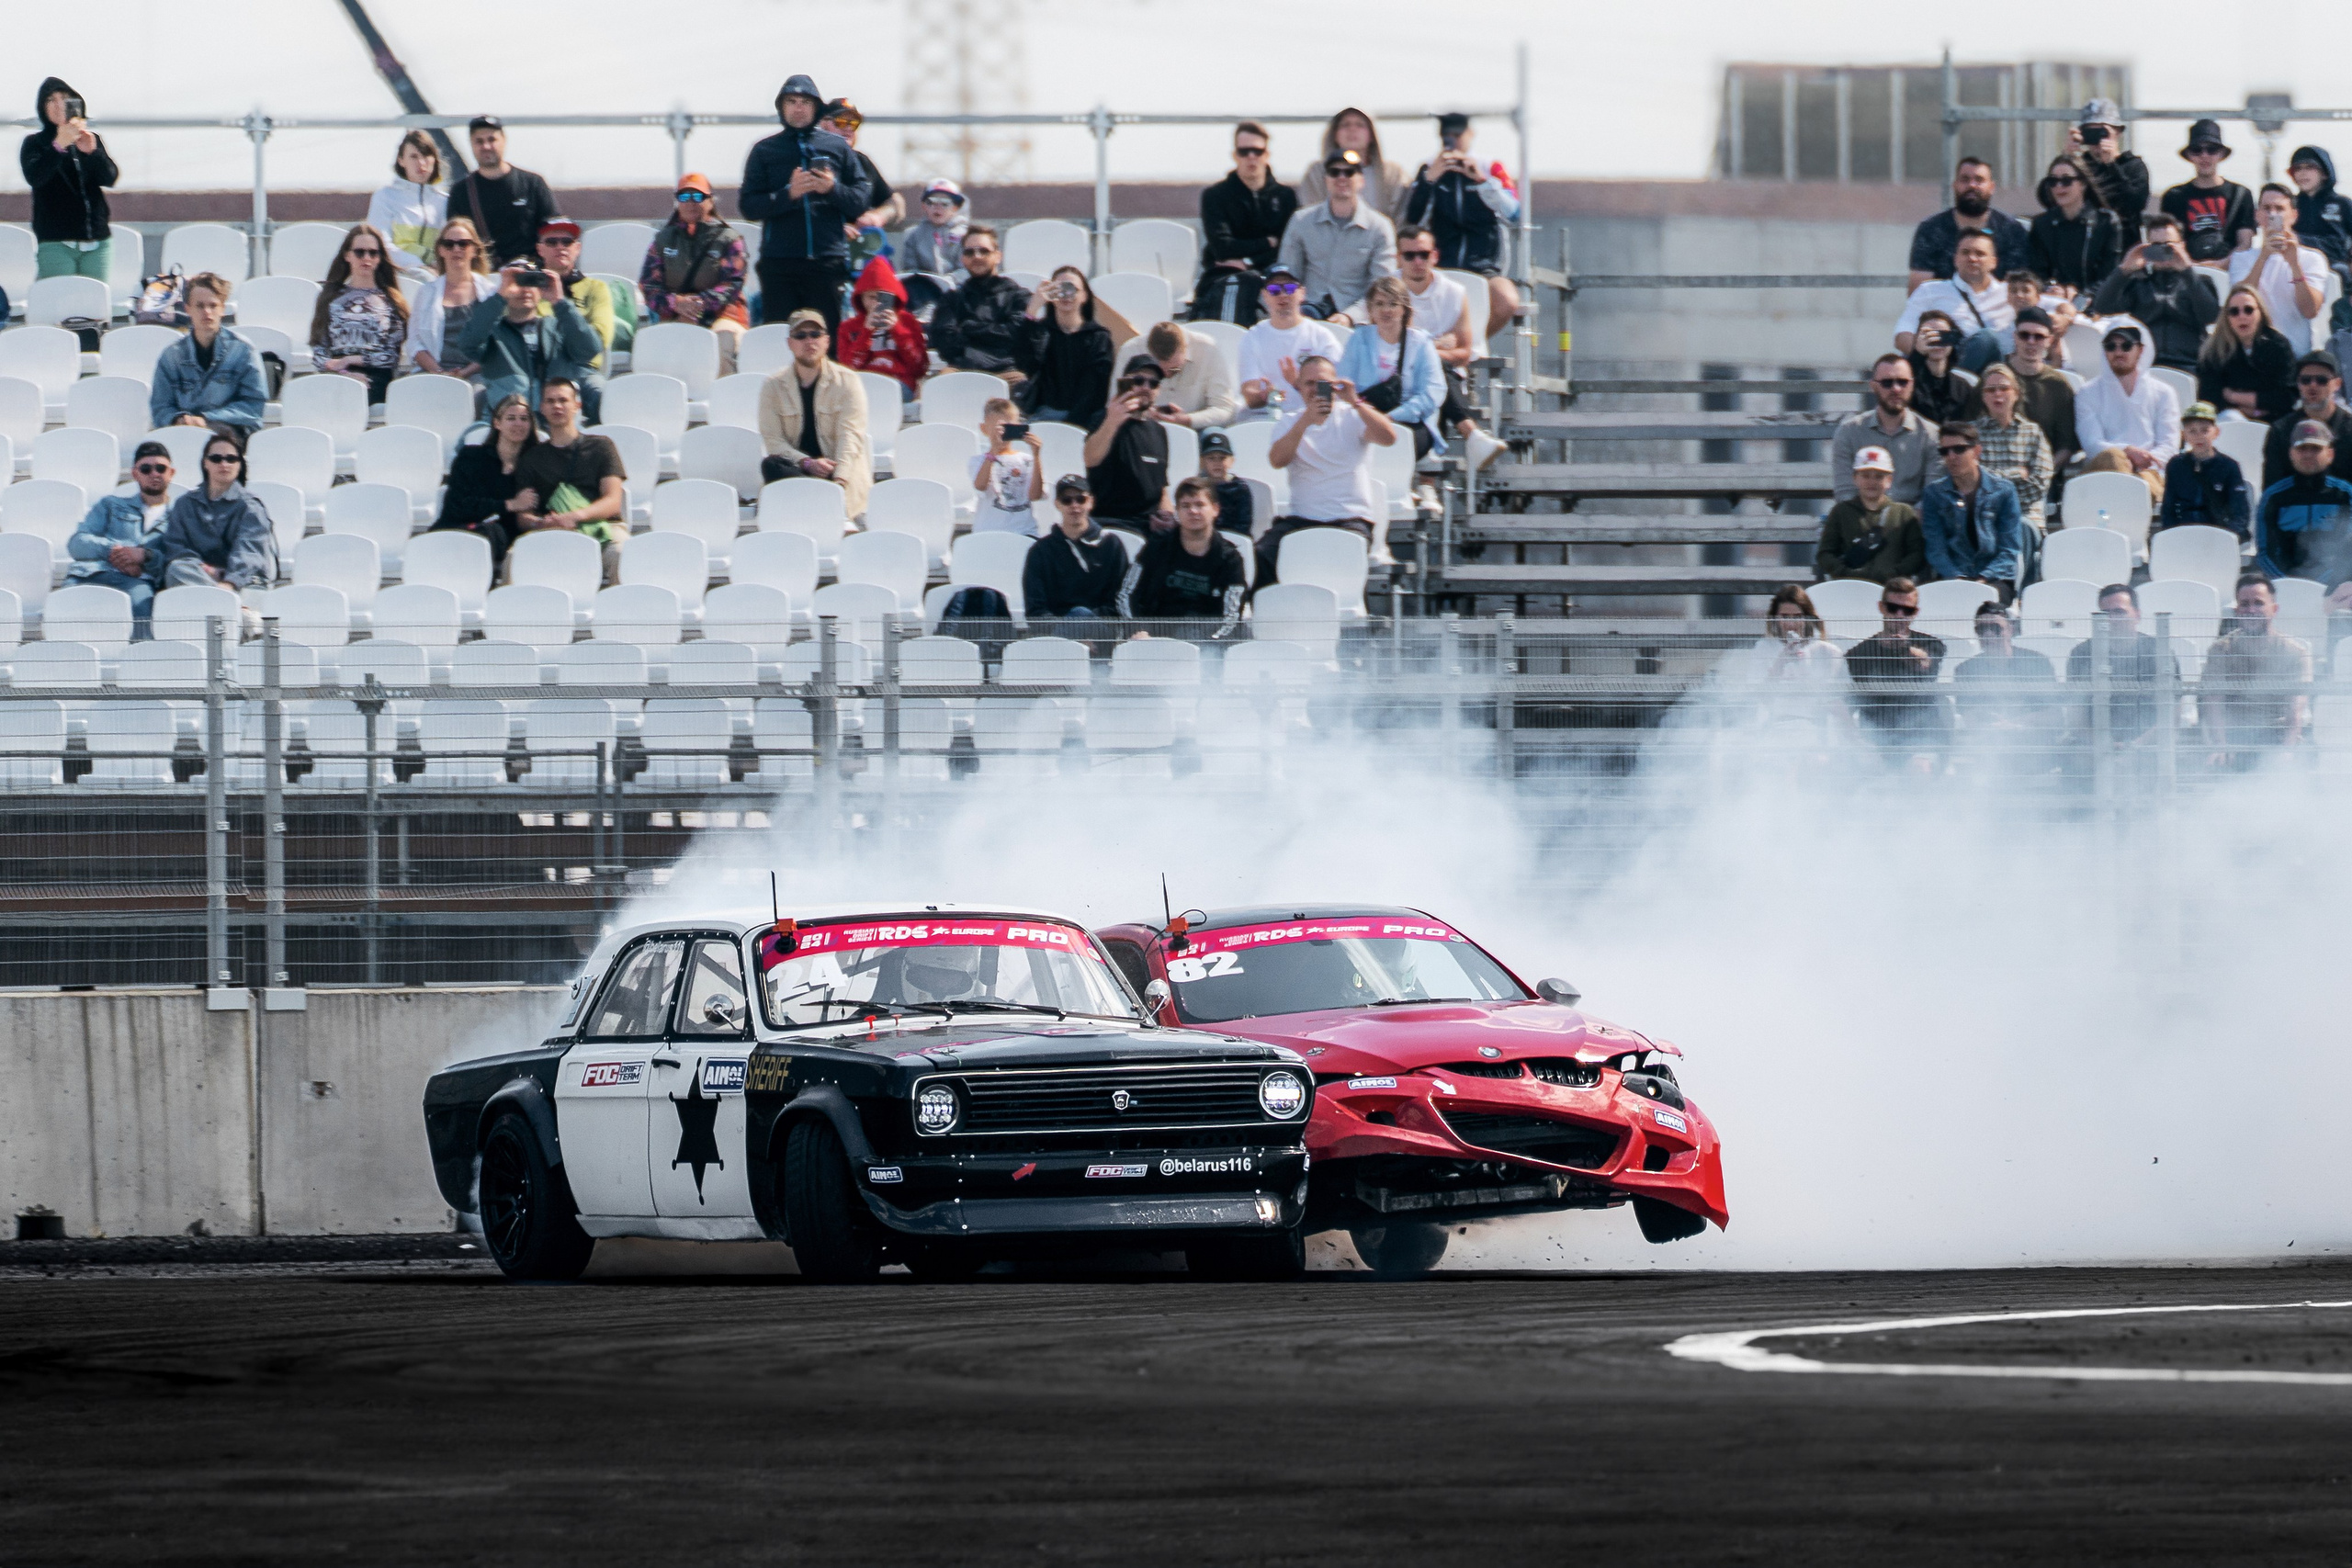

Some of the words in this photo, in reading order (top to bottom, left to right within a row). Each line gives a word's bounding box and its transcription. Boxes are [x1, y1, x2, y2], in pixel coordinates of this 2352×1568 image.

[878, 925, 929, 941] RDS
[952, 928, 995, 936] EUROPE
[1007, 927, 1069, 945] PRO
[1253, 927, 1303, 942] RDS
[1383, 924, 1446, 937] PRO
[1166, 951, 1244, 983] 82
[583, 1065, 619, 1085] FDC
[620, 1064, 643, 1073] DRIFT
[618, 1073, 640, 1081] TEAM
[704, 1066, 743, 1086] AIMOL
[745, 1055, 793, 1091] SHERIFF
[1351, 1079, 1394, 1088] AIMOL
[1159, 1157, 1251, 1176] @belarus116
